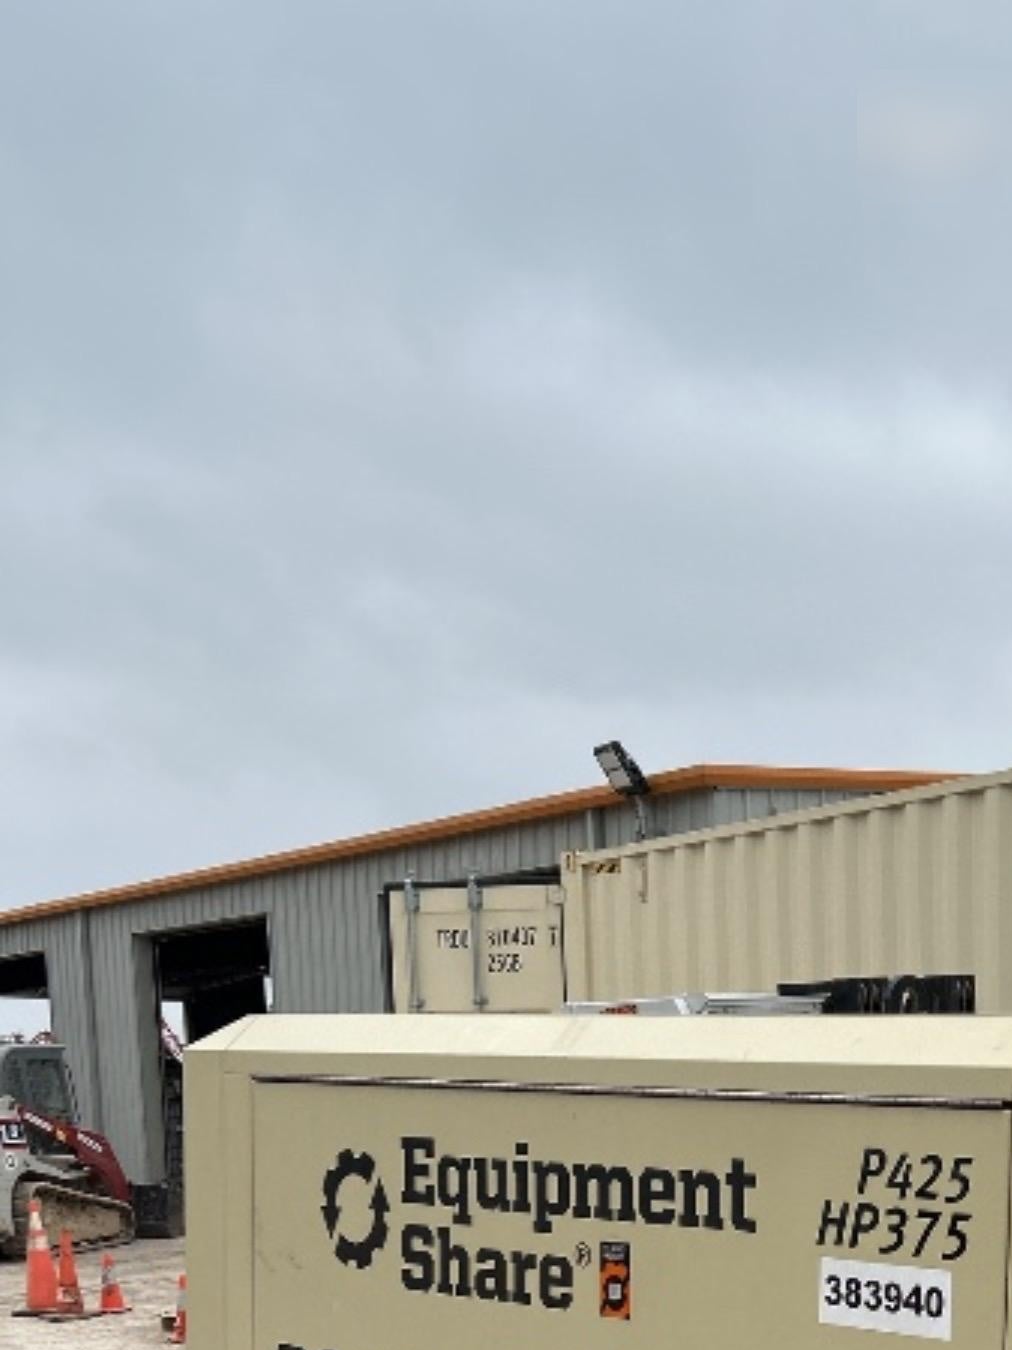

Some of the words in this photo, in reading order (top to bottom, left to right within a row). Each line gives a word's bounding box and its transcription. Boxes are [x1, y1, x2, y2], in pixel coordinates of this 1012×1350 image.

[401, 1137, 757, 1233] Equipment
[857, 1147, 974, 1204] P425
[815, 1199, 973, 1261] HP375
[823, 1274, 944, 1318] 383940
